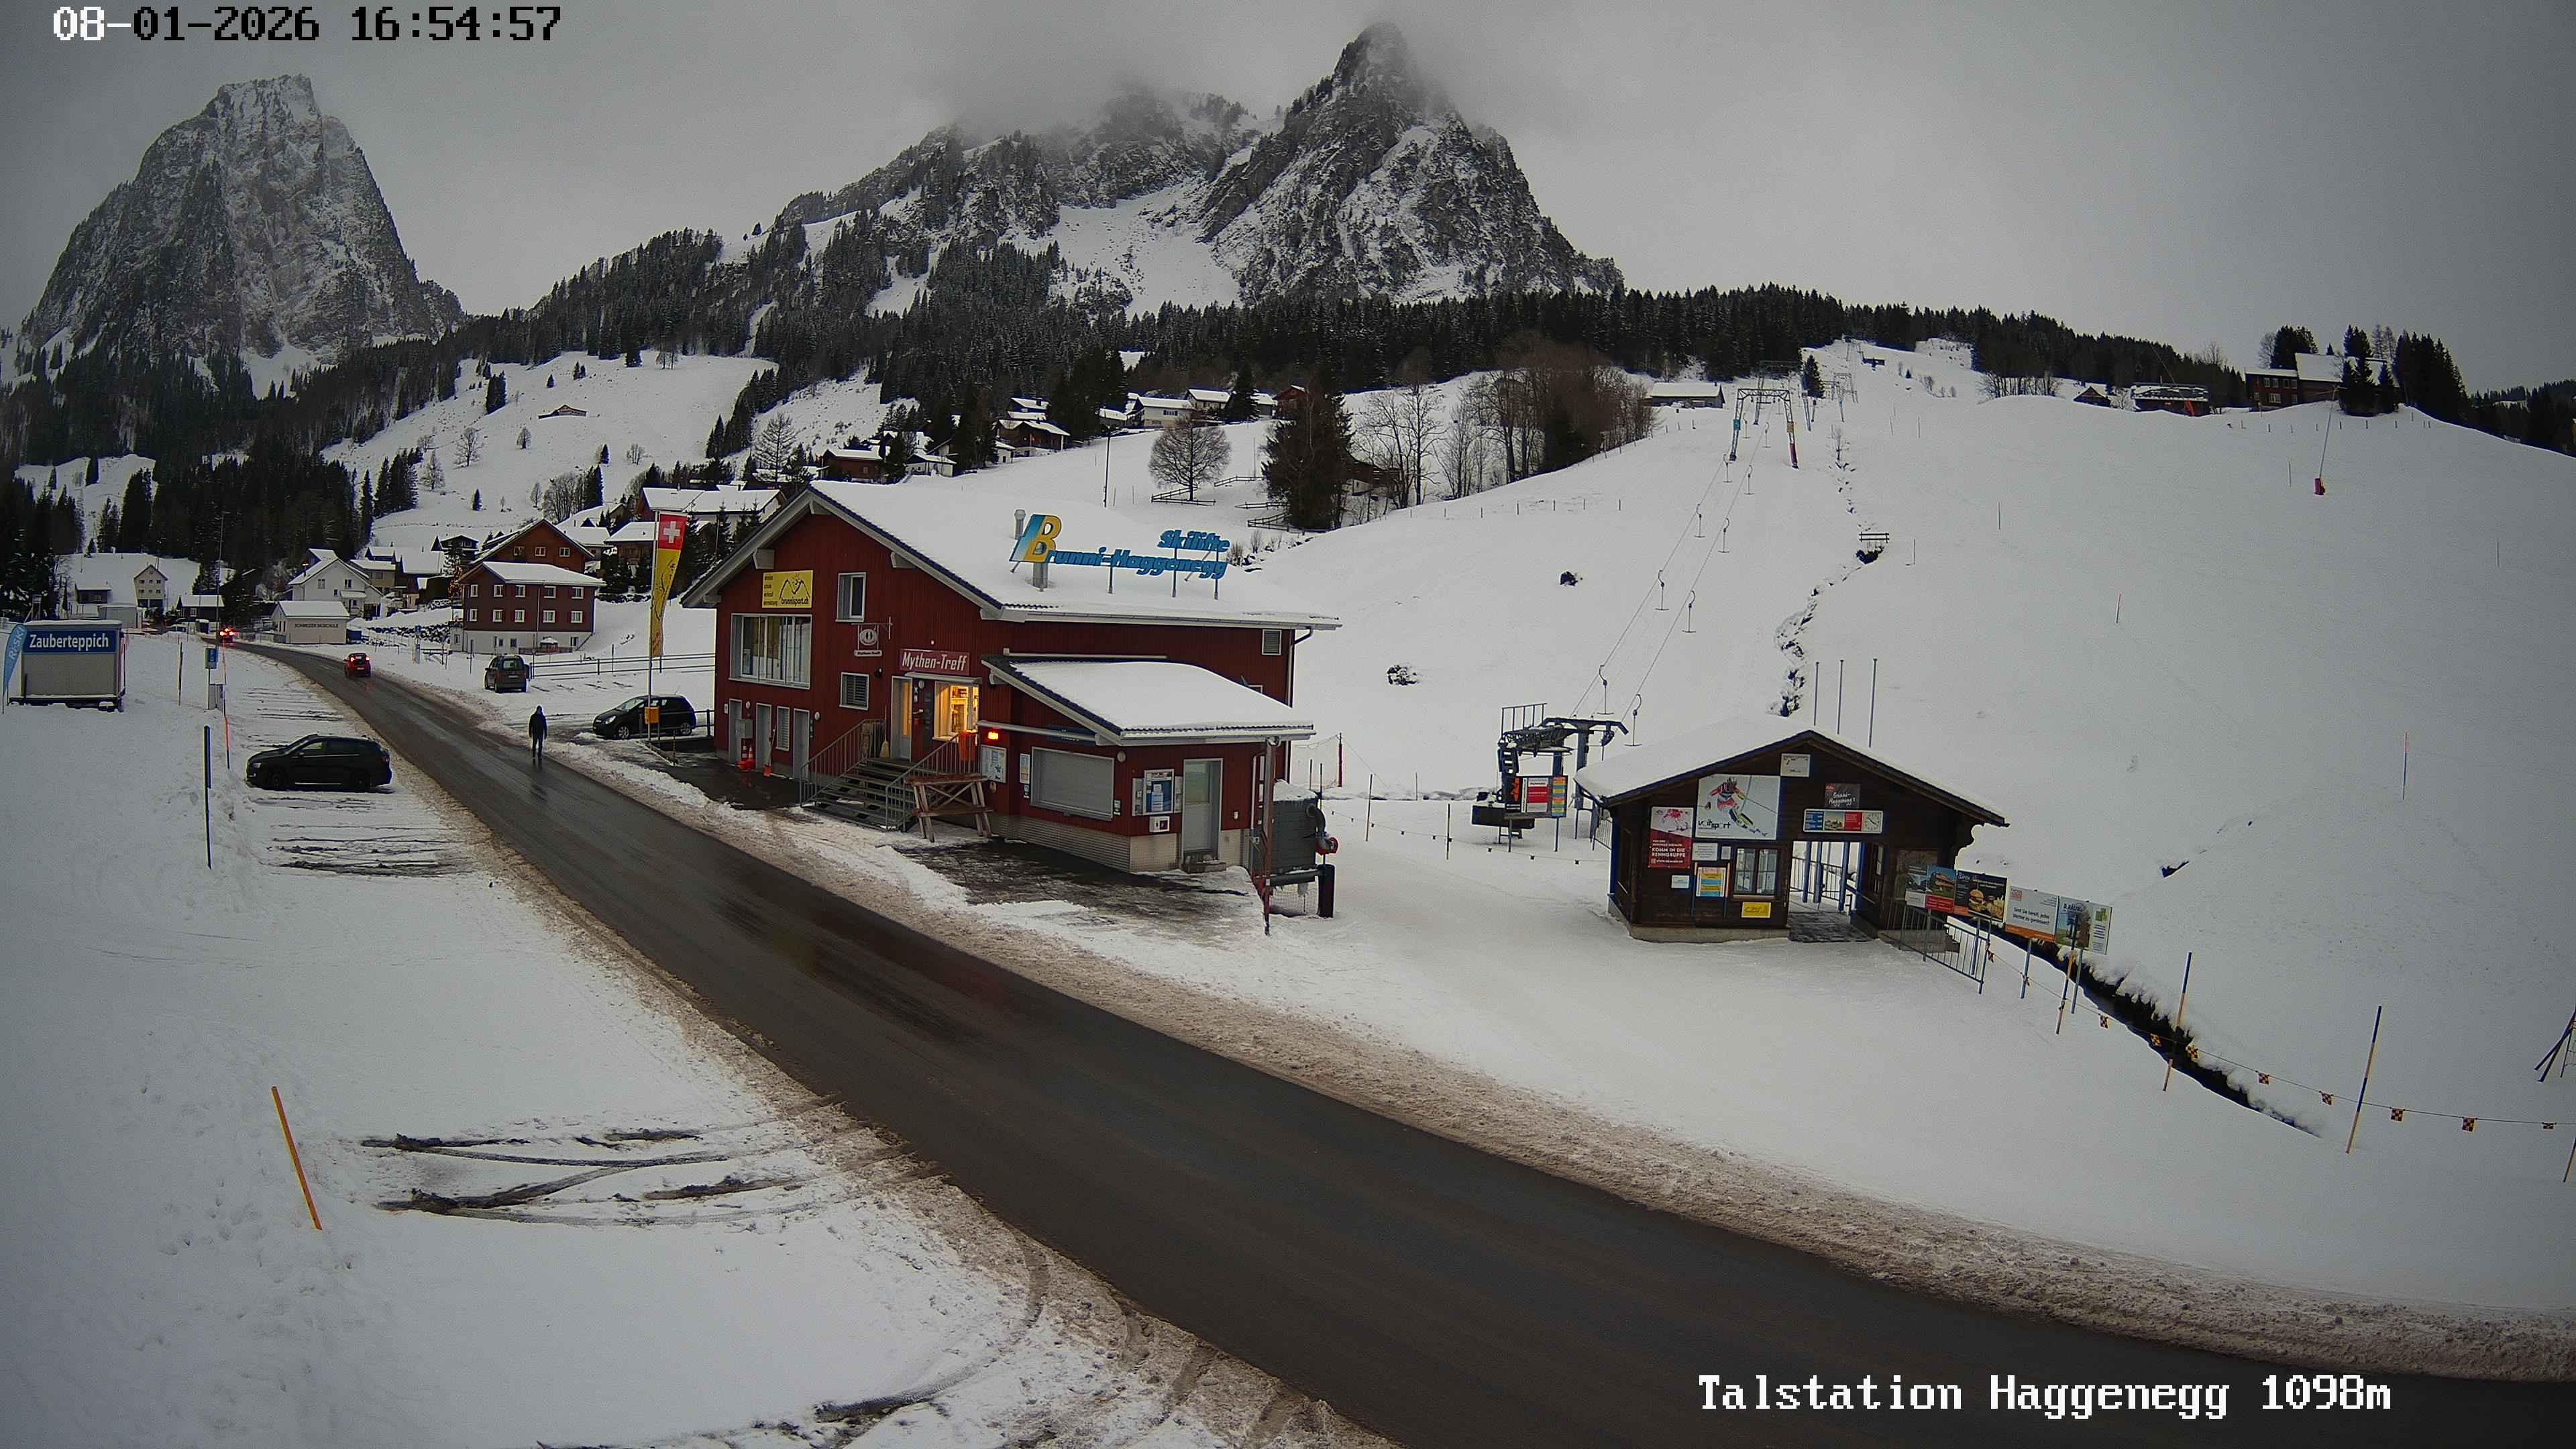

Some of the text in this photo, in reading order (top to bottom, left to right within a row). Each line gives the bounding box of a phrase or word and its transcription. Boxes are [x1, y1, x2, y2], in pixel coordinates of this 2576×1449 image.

[1010, 513, 1228, 580] Brunni-Haggenegg
[1158, 529, 1230, 553] Skilifte
[29, 633, 109, 651] Zauberteppich
[902, 651, 967, 672] Mythen-Treff
